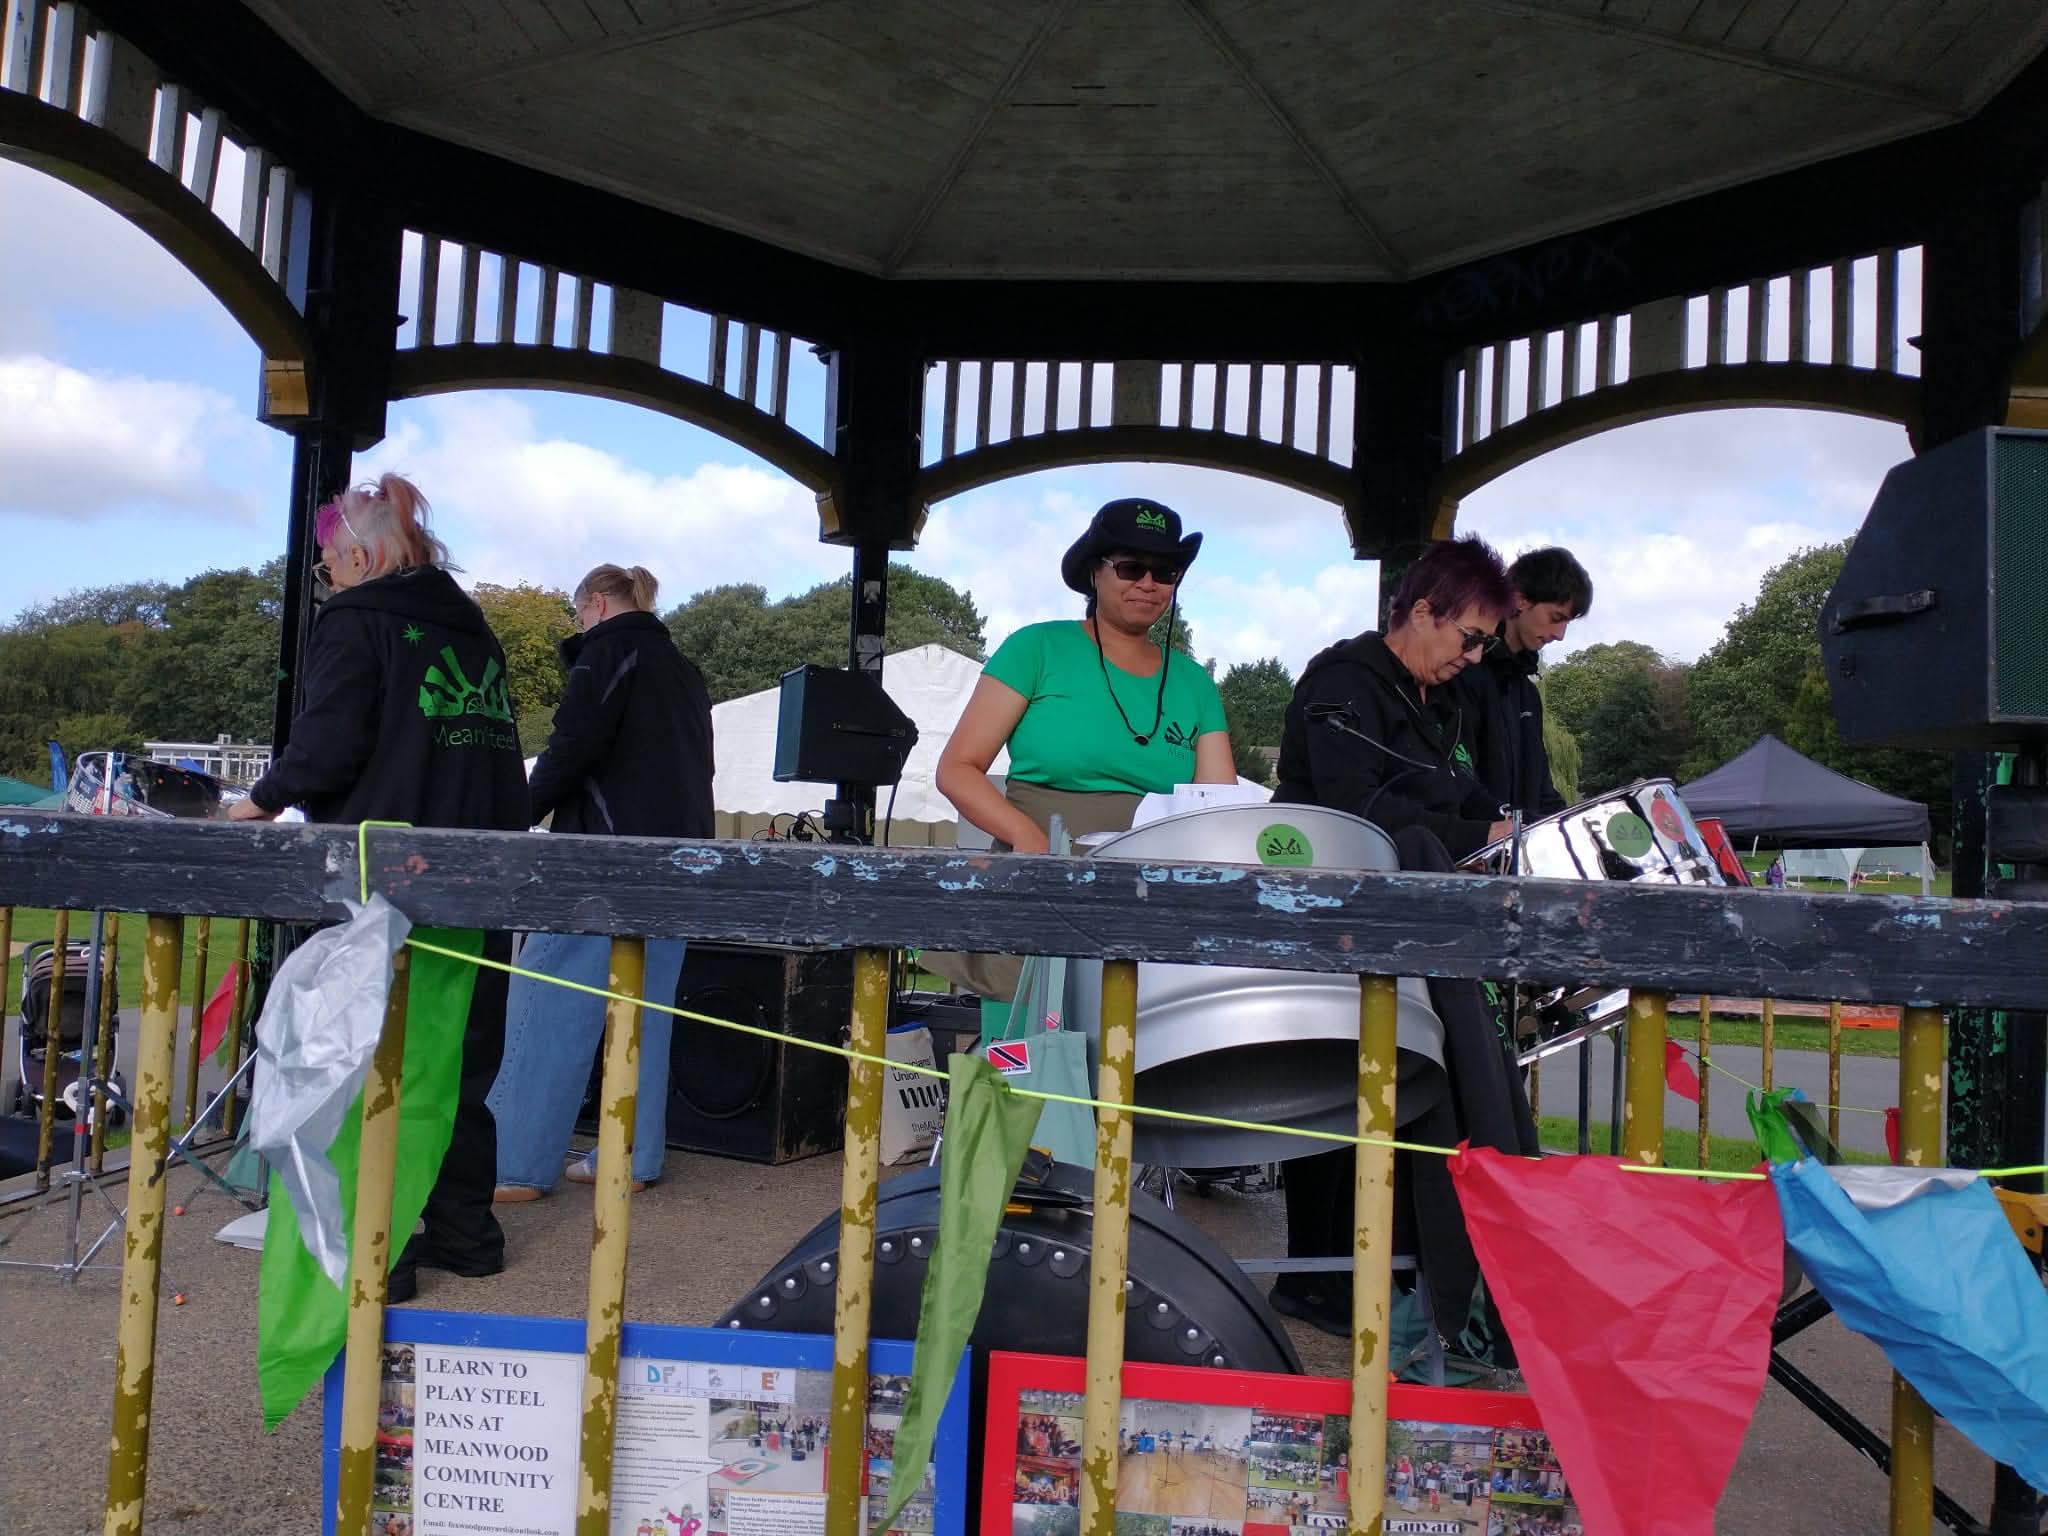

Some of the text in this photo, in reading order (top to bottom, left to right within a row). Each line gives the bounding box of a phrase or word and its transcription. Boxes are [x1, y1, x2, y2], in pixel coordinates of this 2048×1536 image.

[893, 1071, 920, 1082] Union
[424, 1357, 528, 1379] LEARN TO
[425, 1384, 545, 1407] PLAY STEEL
[425, 1411, 504, 1432] PANS AT
[424, 1438, 549, 1462] MEANWOOD
[423, 1465, 555, 1489] COMMUNITY
[423, 1492, 505, 1513] CENTRE
